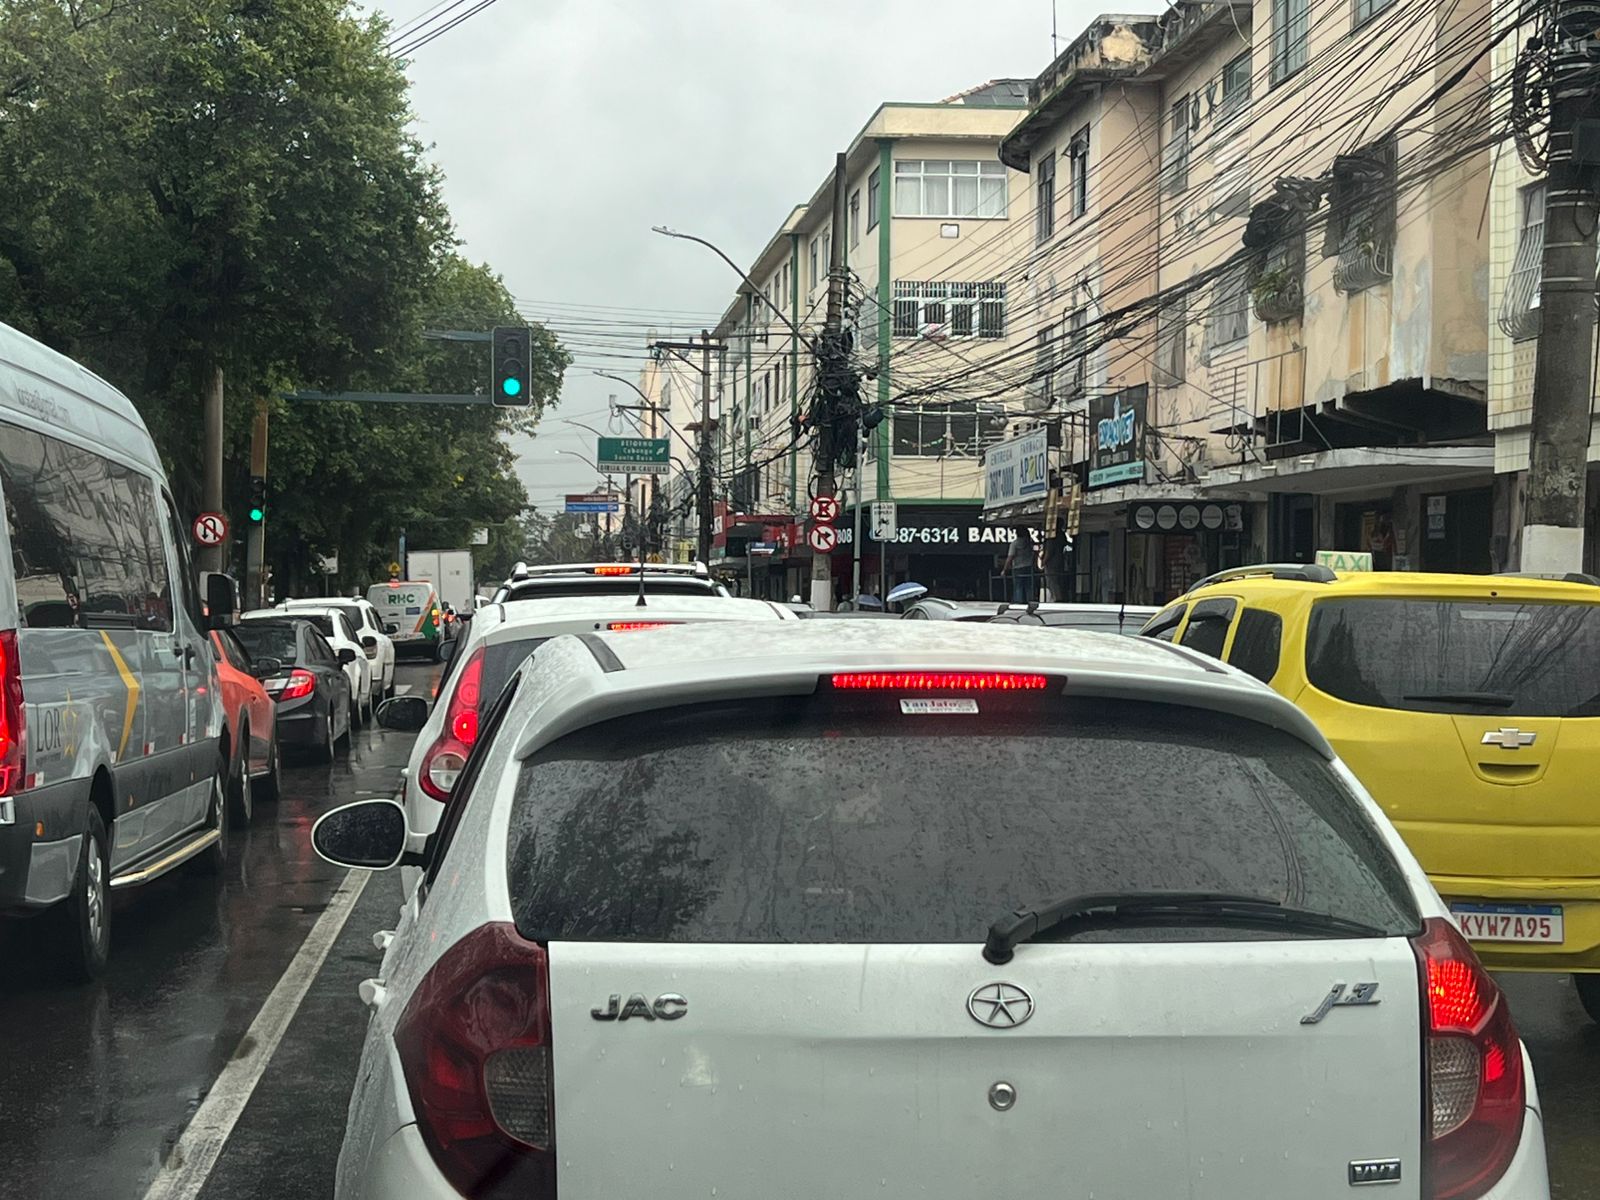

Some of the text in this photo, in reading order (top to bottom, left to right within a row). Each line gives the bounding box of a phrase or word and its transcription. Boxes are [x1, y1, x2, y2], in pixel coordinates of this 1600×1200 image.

[1321, 553, 1369, 571] TAXI
[1461, 915, 1551, 938] KYW7A95
[590, 992, 688, 1022] JAC
